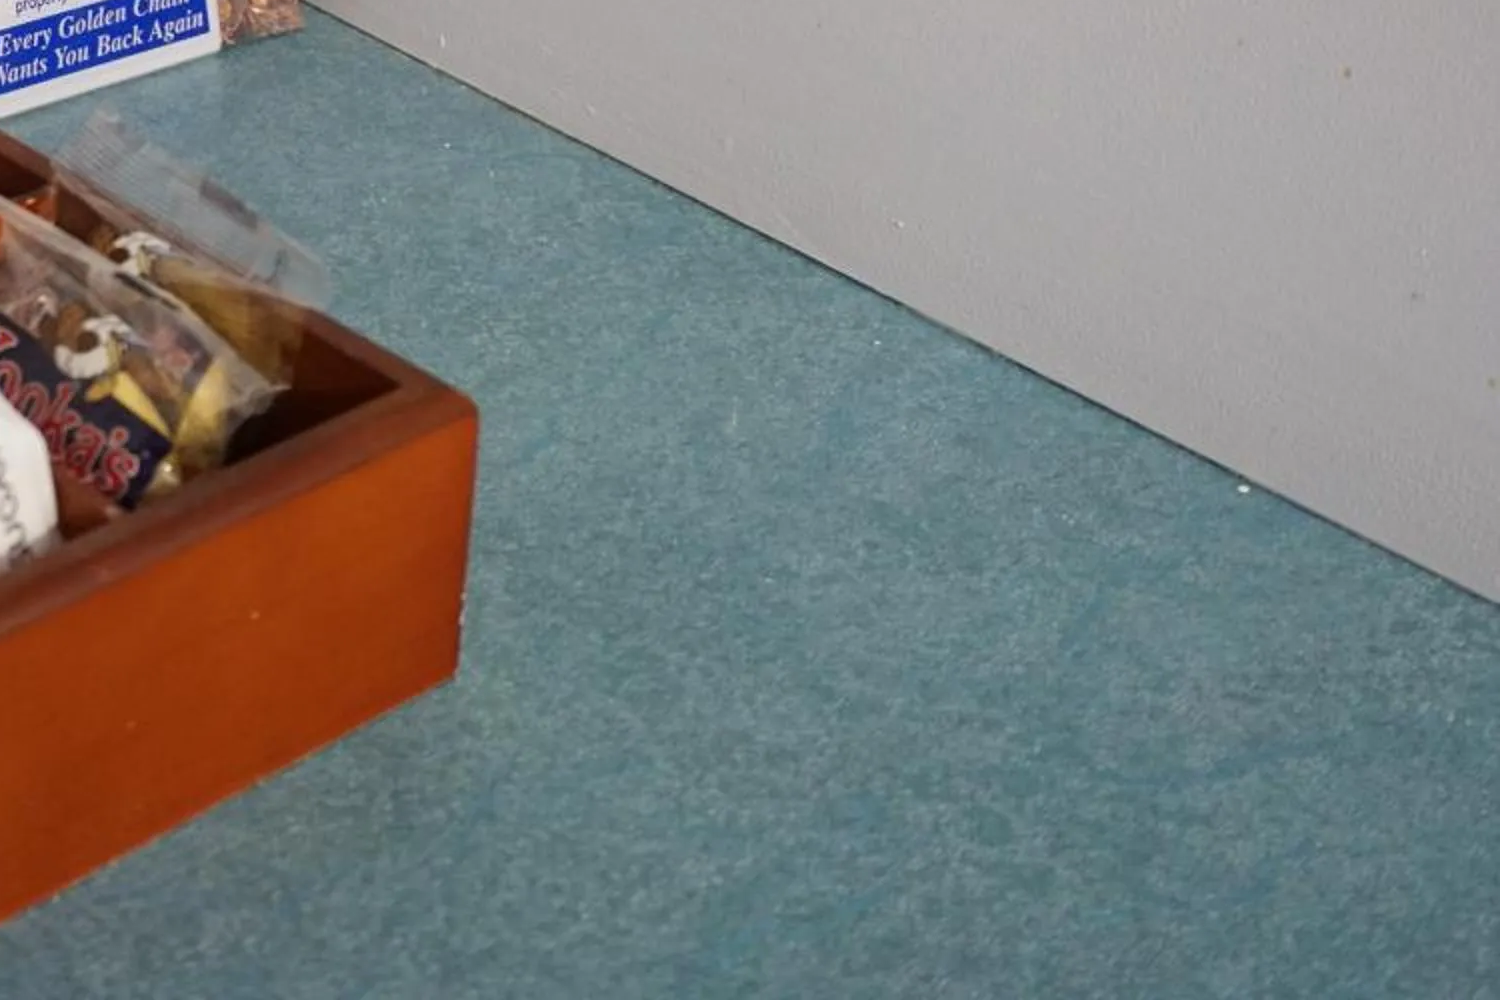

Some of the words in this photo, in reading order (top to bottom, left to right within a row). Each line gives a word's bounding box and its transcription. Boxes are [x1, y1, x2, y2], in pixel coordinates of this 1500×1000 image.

[55, 45, 89, 70] You
[97, 25, 143, 57] Back
[148, 10, 204, 43] Again
[58, 3, 127, 39] Golden
